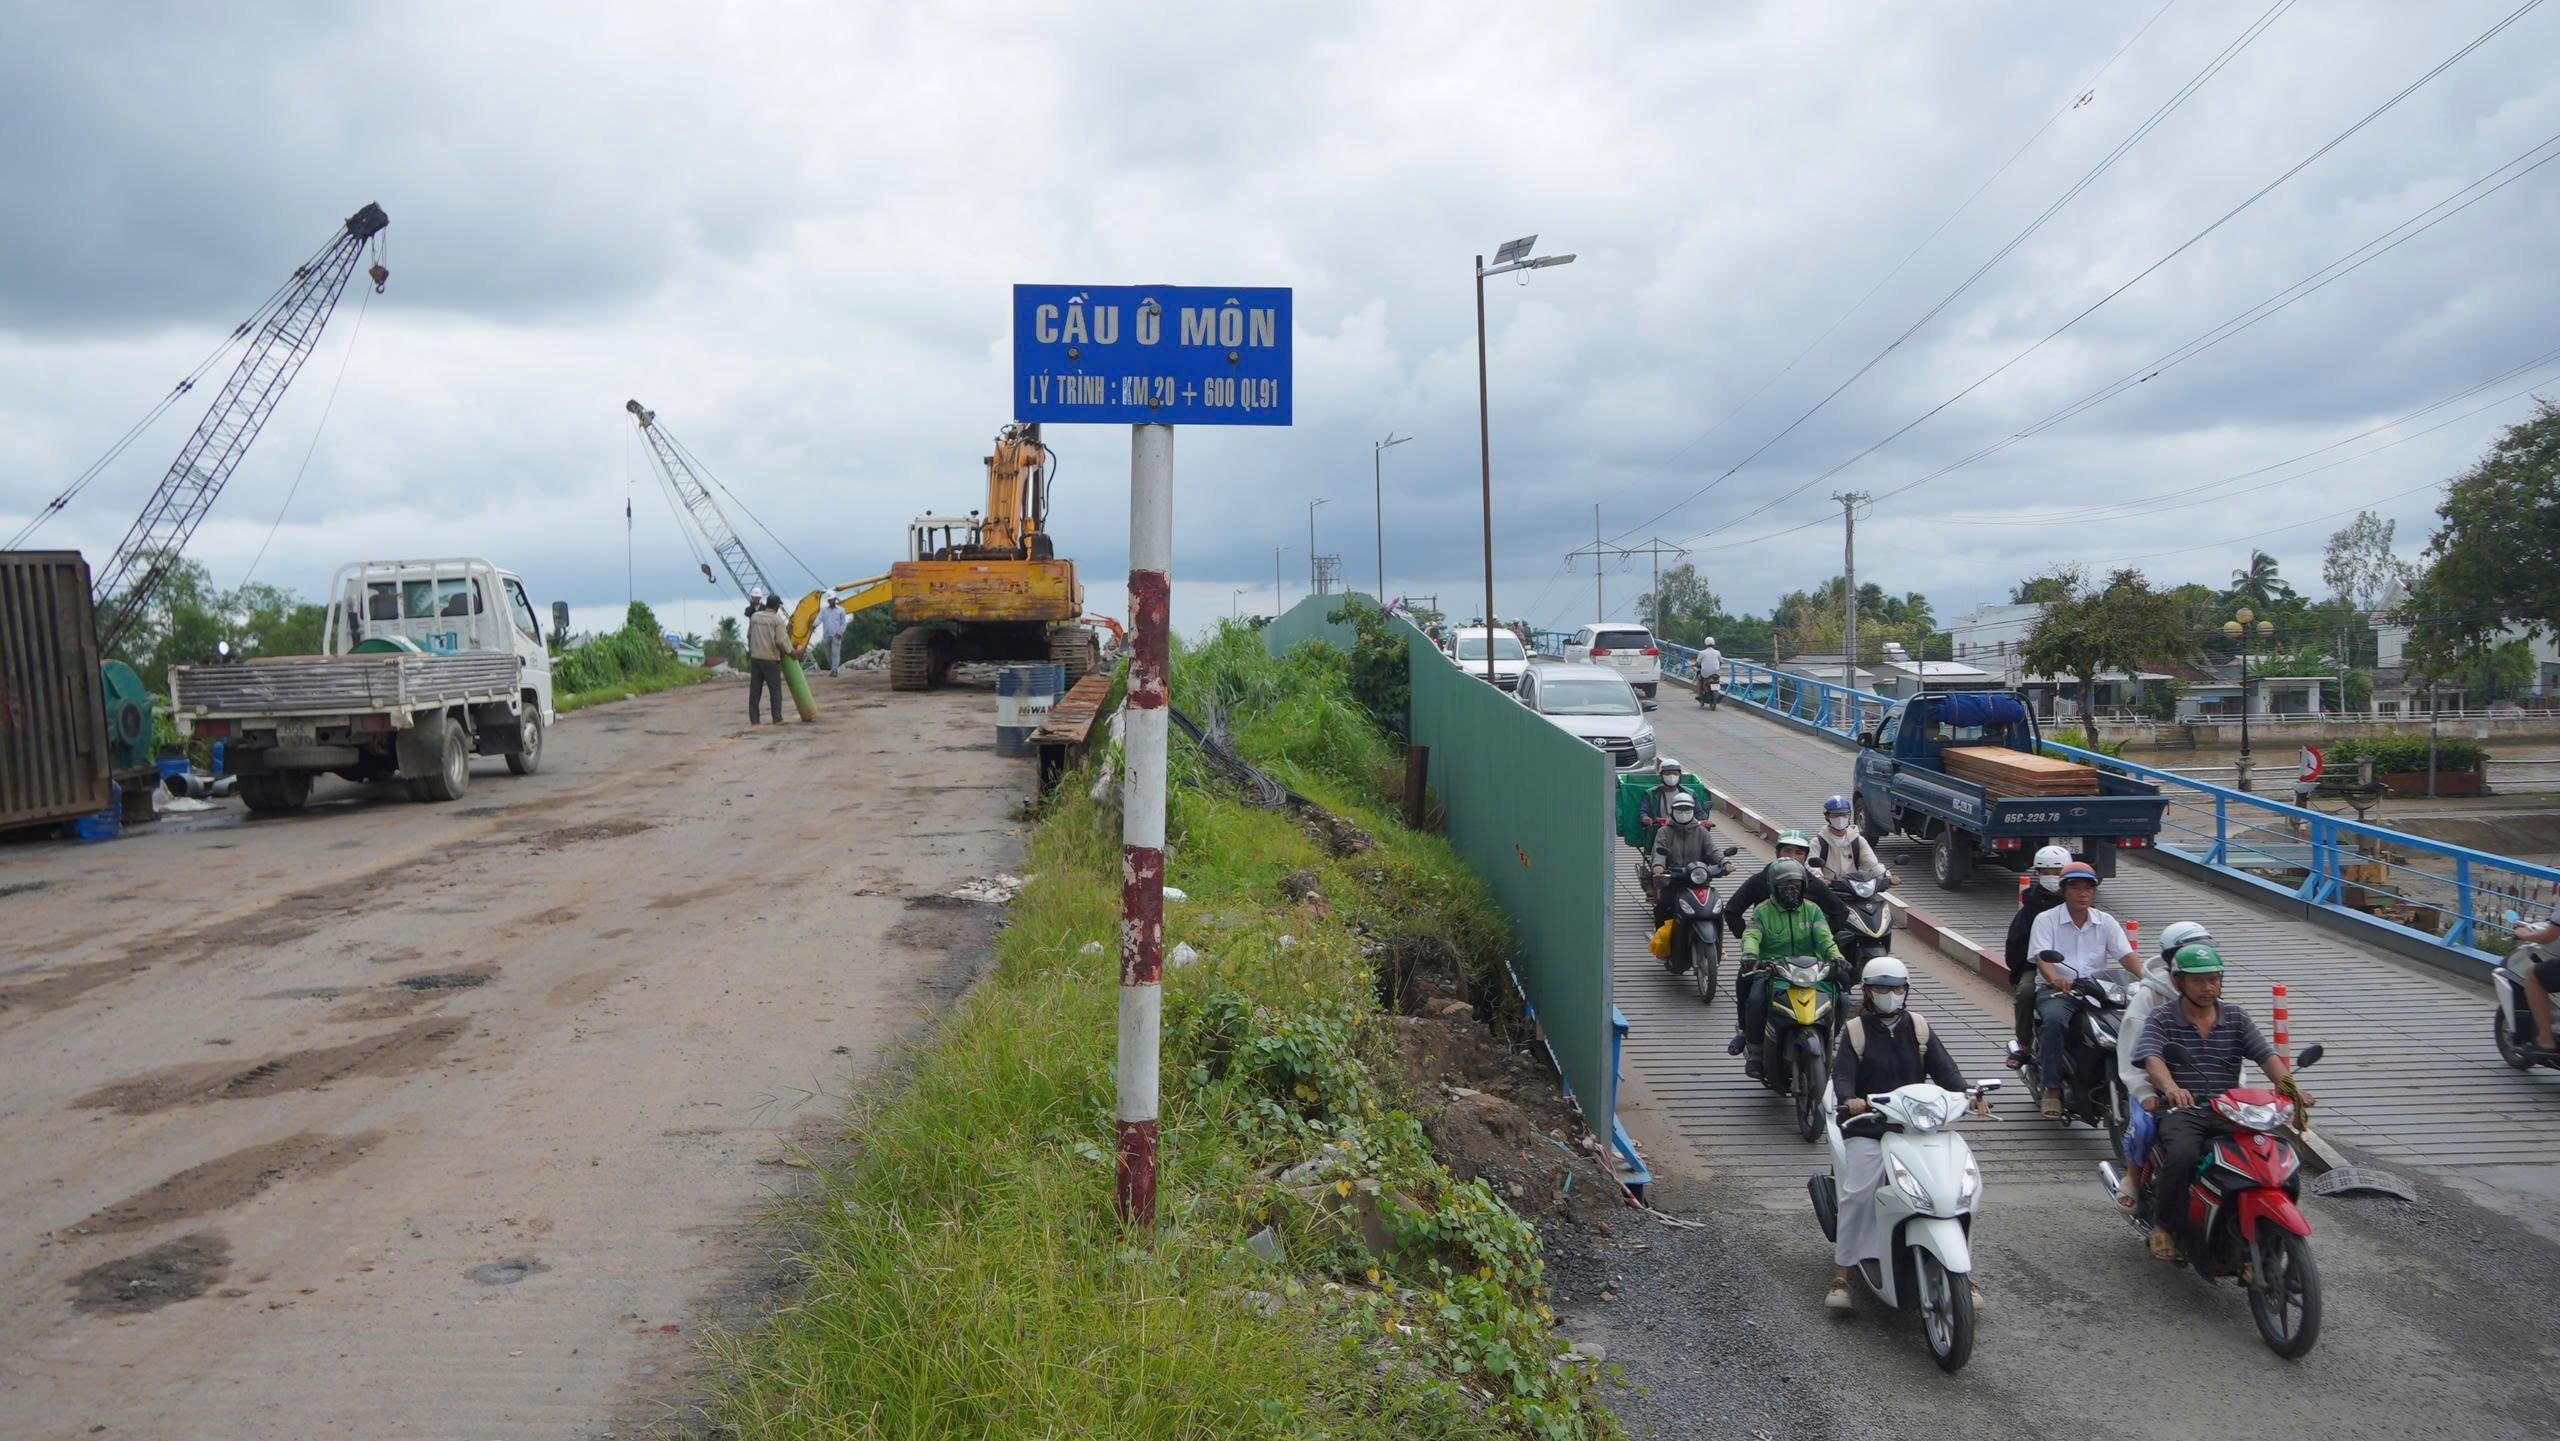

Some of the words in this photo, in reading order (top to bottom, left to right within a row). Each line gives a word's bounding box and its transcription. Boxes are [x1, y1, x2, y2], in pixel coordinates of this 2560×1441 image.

[1035, 292, 1119, 345] CẦU
[1136, 297, 1161, 346] Ô
[1180, 297, 1276, 347] MÔN
[1029, 368, 1049, 404] LÝ
[1057, 369, 1105, 405] TRÌNH
[1181, 382, 1198, 406] +
[1204, 377, 1235, 407] 600
[1240, 378, 1278, 411] QL91
[2004, 812, 2061, 823] 65C-229.76
